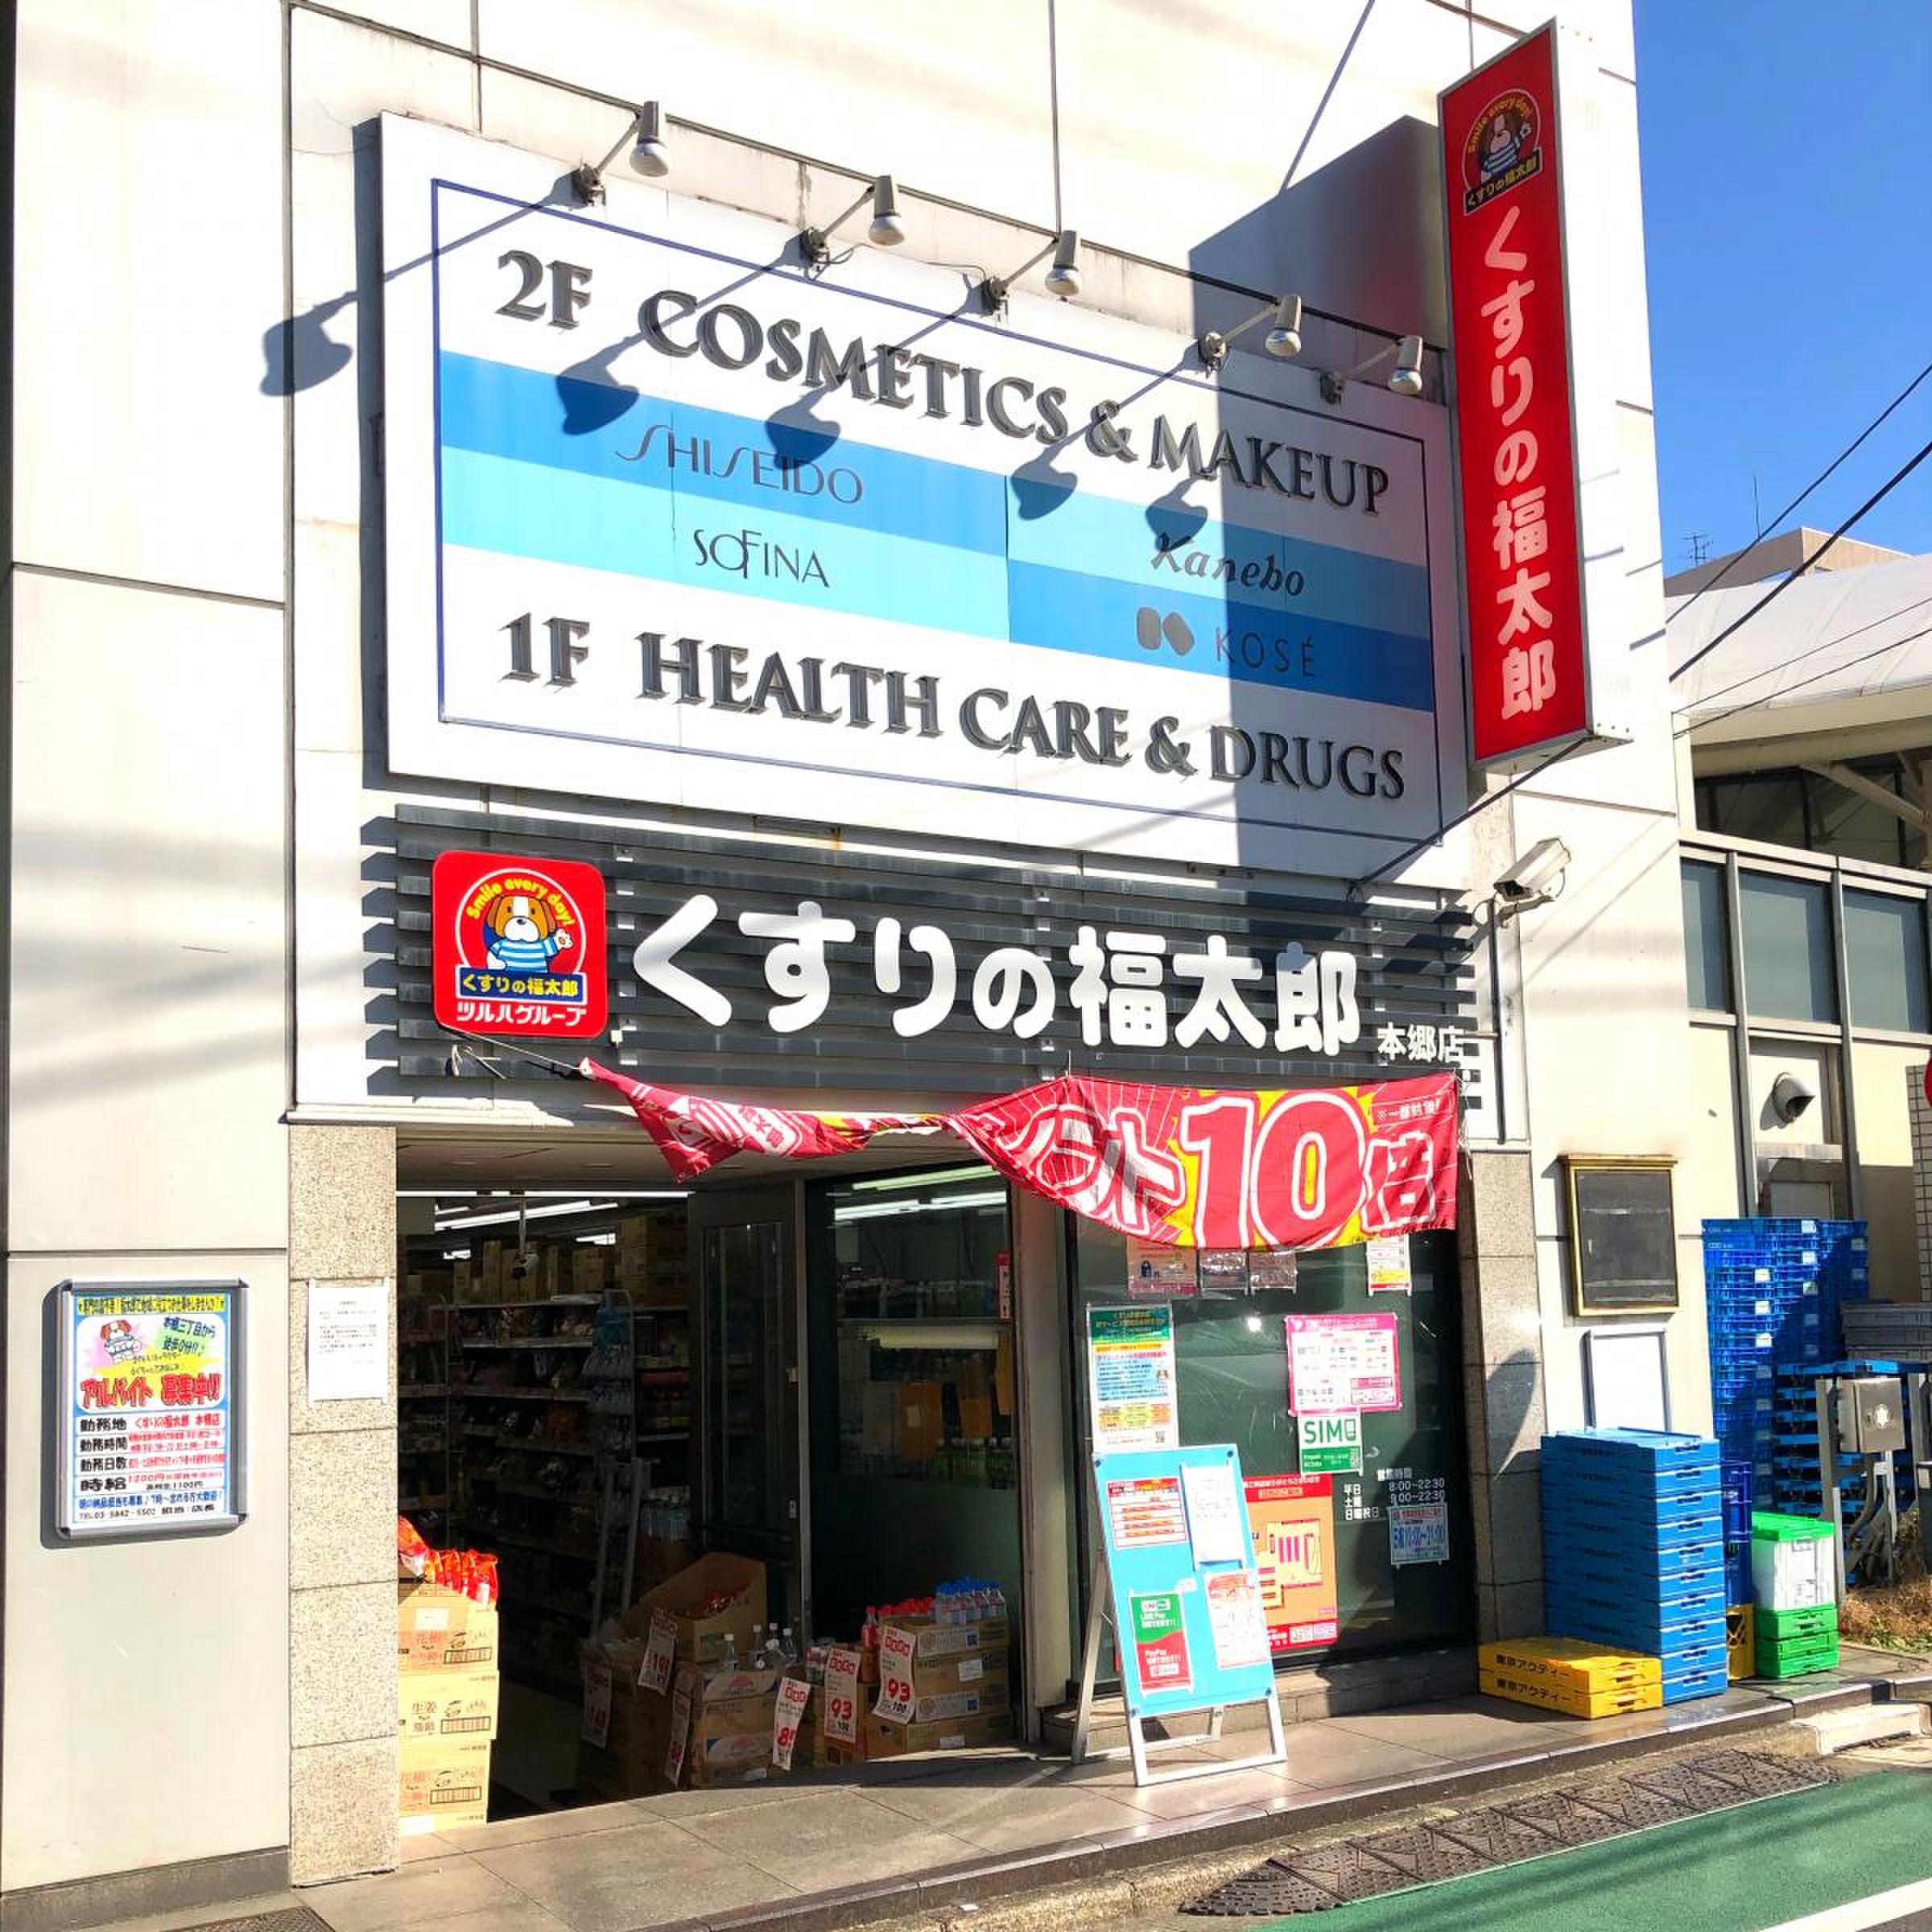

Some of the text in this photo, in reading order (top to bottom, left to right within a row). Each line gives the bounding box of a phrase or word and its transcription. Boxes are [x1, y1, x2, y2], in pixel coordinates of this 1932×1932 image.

[1468, 158, 1537, 206] くすりの福太郎
[495, 250, 1389, 516] 2F COSMETICS & MAKEUP
[616, 423, 864, 504] SHISEIDO
[1480, 204, 1556, 720] くすりの福太郎
[692, 528, 830, 588] SOFINA
[1150, 531, 1305, 597] Kanebo
[1215, 626, 1315, 679] KOSÉ
[496, 612, 1406, 800] 1F HEALTH CARE & DRUGS
[466, 877, 576, 927] Smile every day!
[462, 973, 579, 997] くすりの福太郎
[632, 893, 1464, 1063] くすりの福太郎 本郷店
[456, 1001, 588, 1027] ツルハグループ
[80, 1376, 154, 1409] アルバイト
[80, 1417, 127, 1432] 勤務地
[80, 1436, 128, 1452] 勤務時間
[1303, 1419, 1343, 1444] SIM
[80, 1455, 129, 1472] 勤務日数
[80, 1476, 127, 1492] 時給
[887, 1678, 911, 1702] 93
